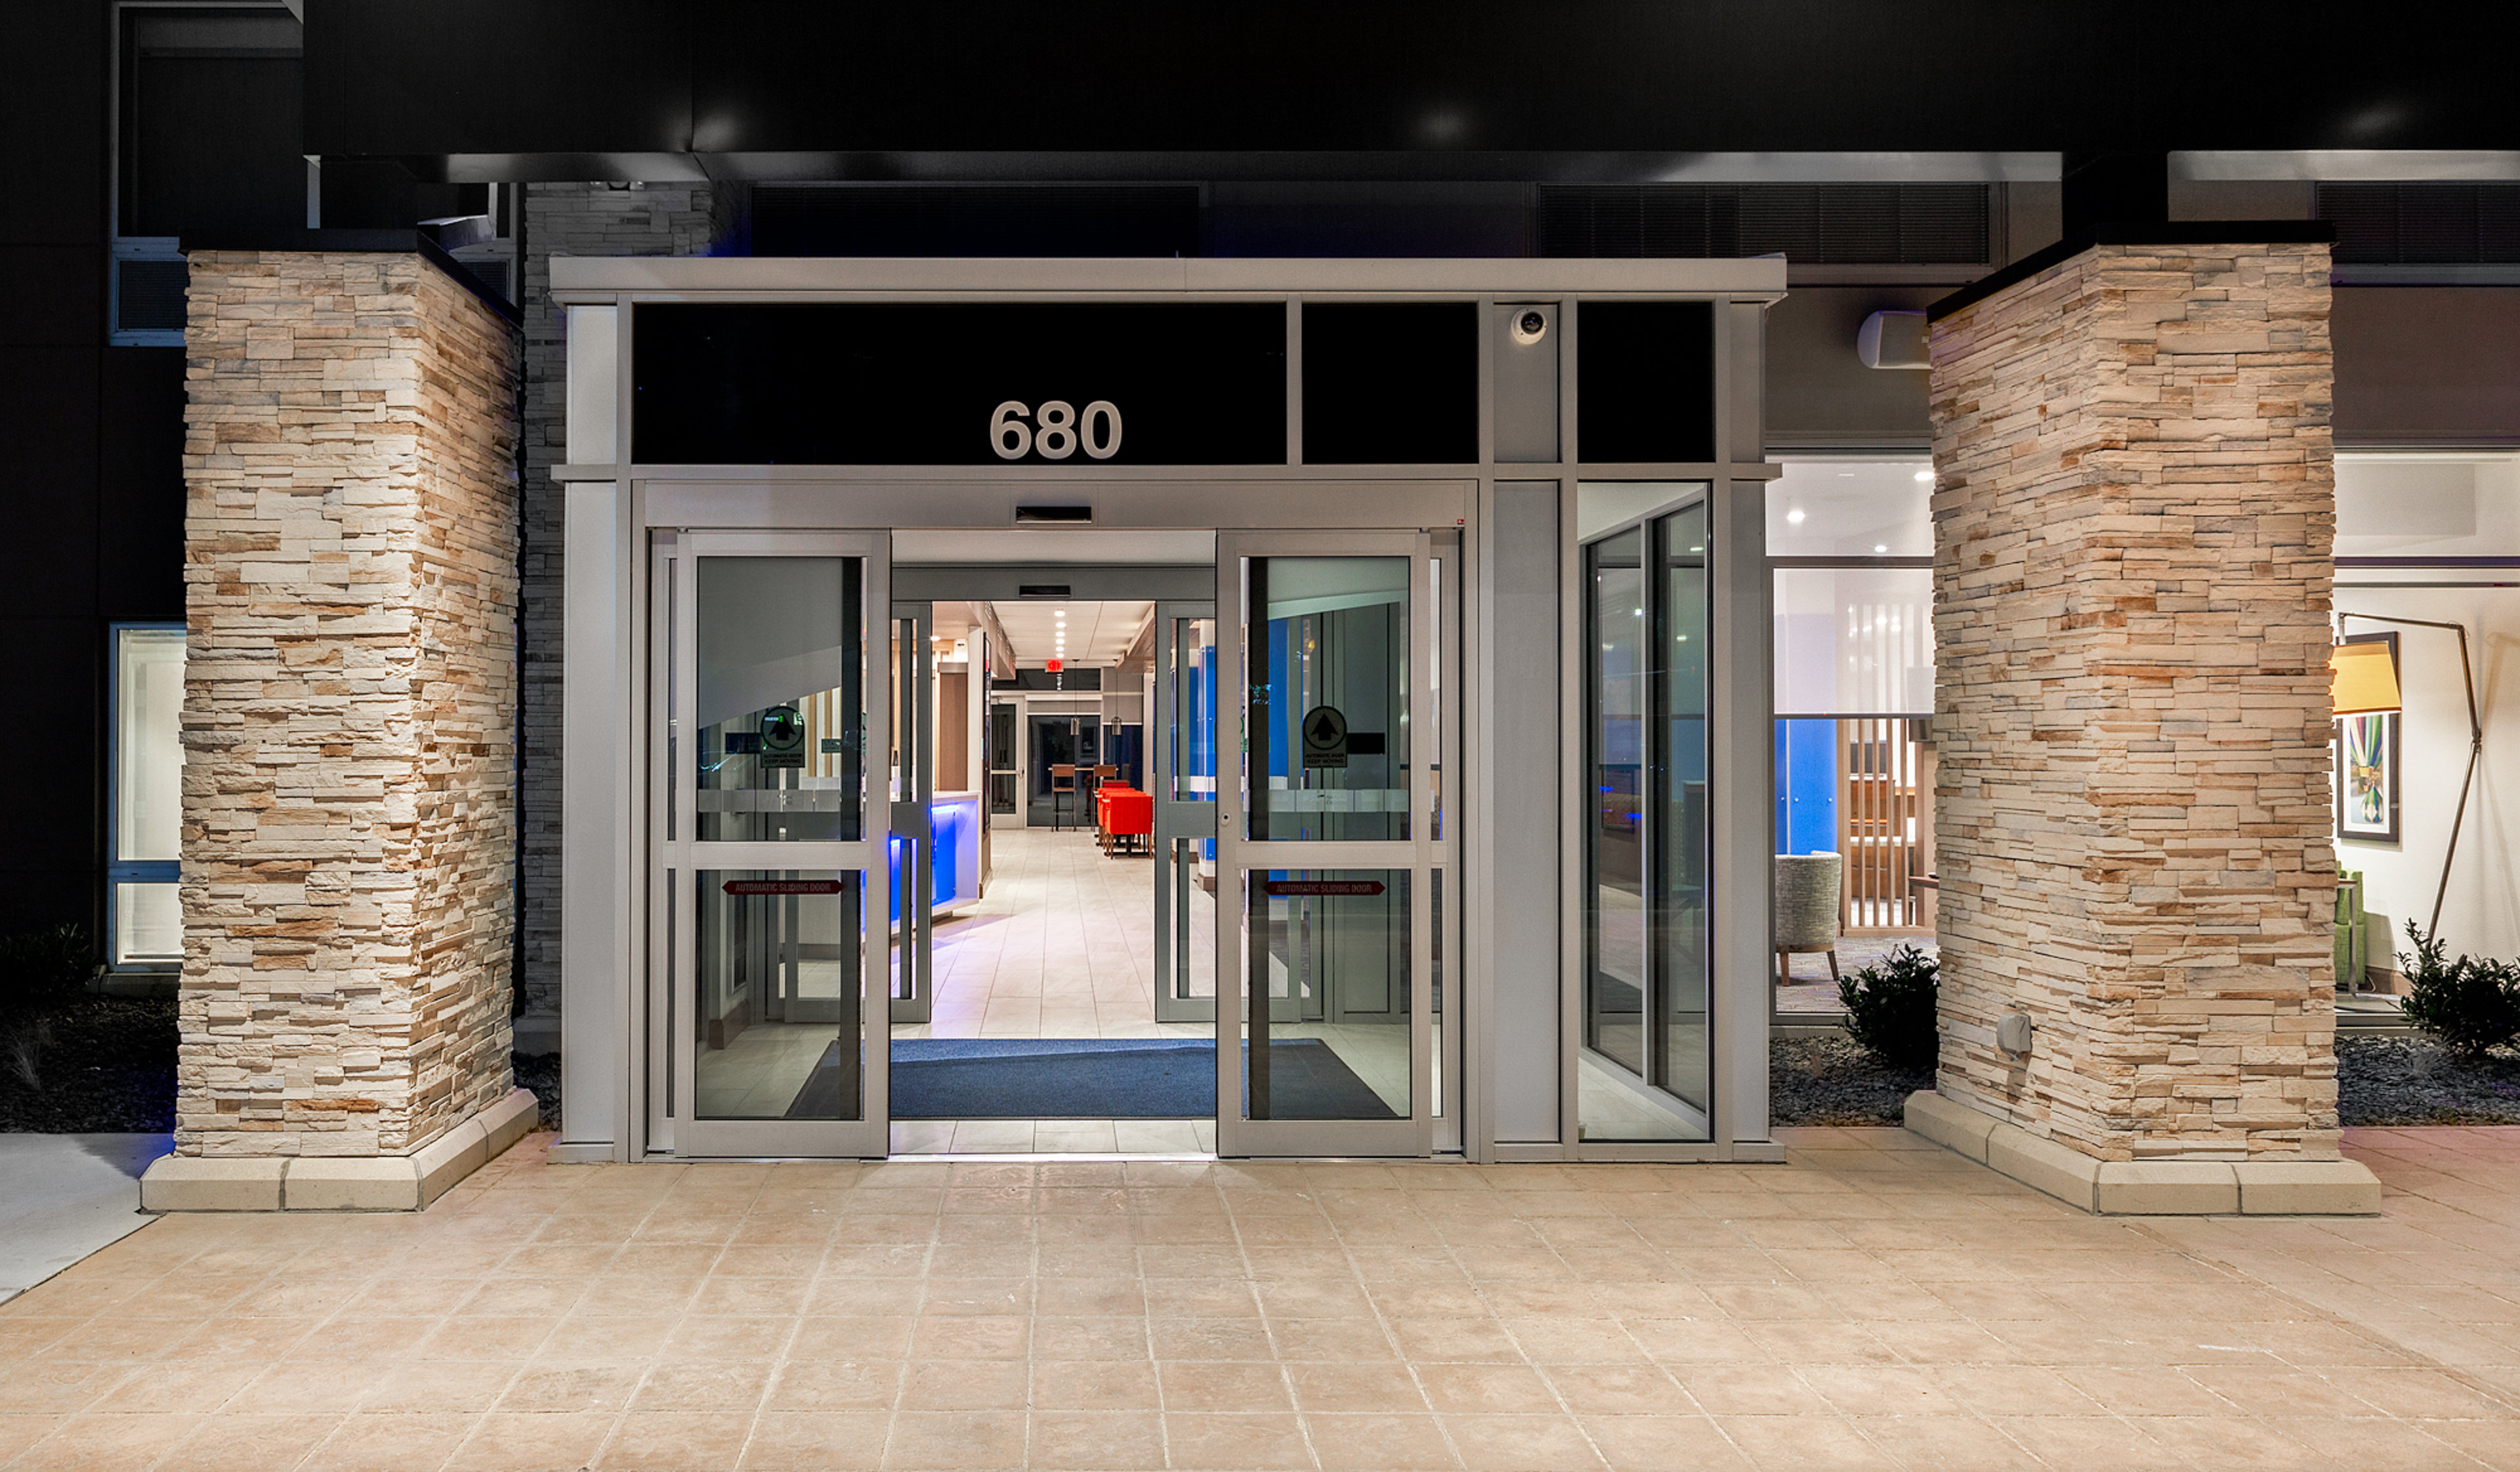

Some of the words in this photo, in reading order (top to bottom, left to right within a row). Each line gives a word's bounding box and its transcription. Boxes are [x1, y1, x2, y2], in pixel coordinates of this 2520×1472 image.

[990, 400, 1122, 460] 680
[735, 883, 778, 892] AUTOMATIC
[779, 883, 808, 892] SLIDING
[810, 883, 831, 892] DOOR
[1276, 884, 1319, 893] AUTOMATIC
[1320, 884, 1350, 893] SLIDING
[1351, 884, 1372, 893] DOOR
